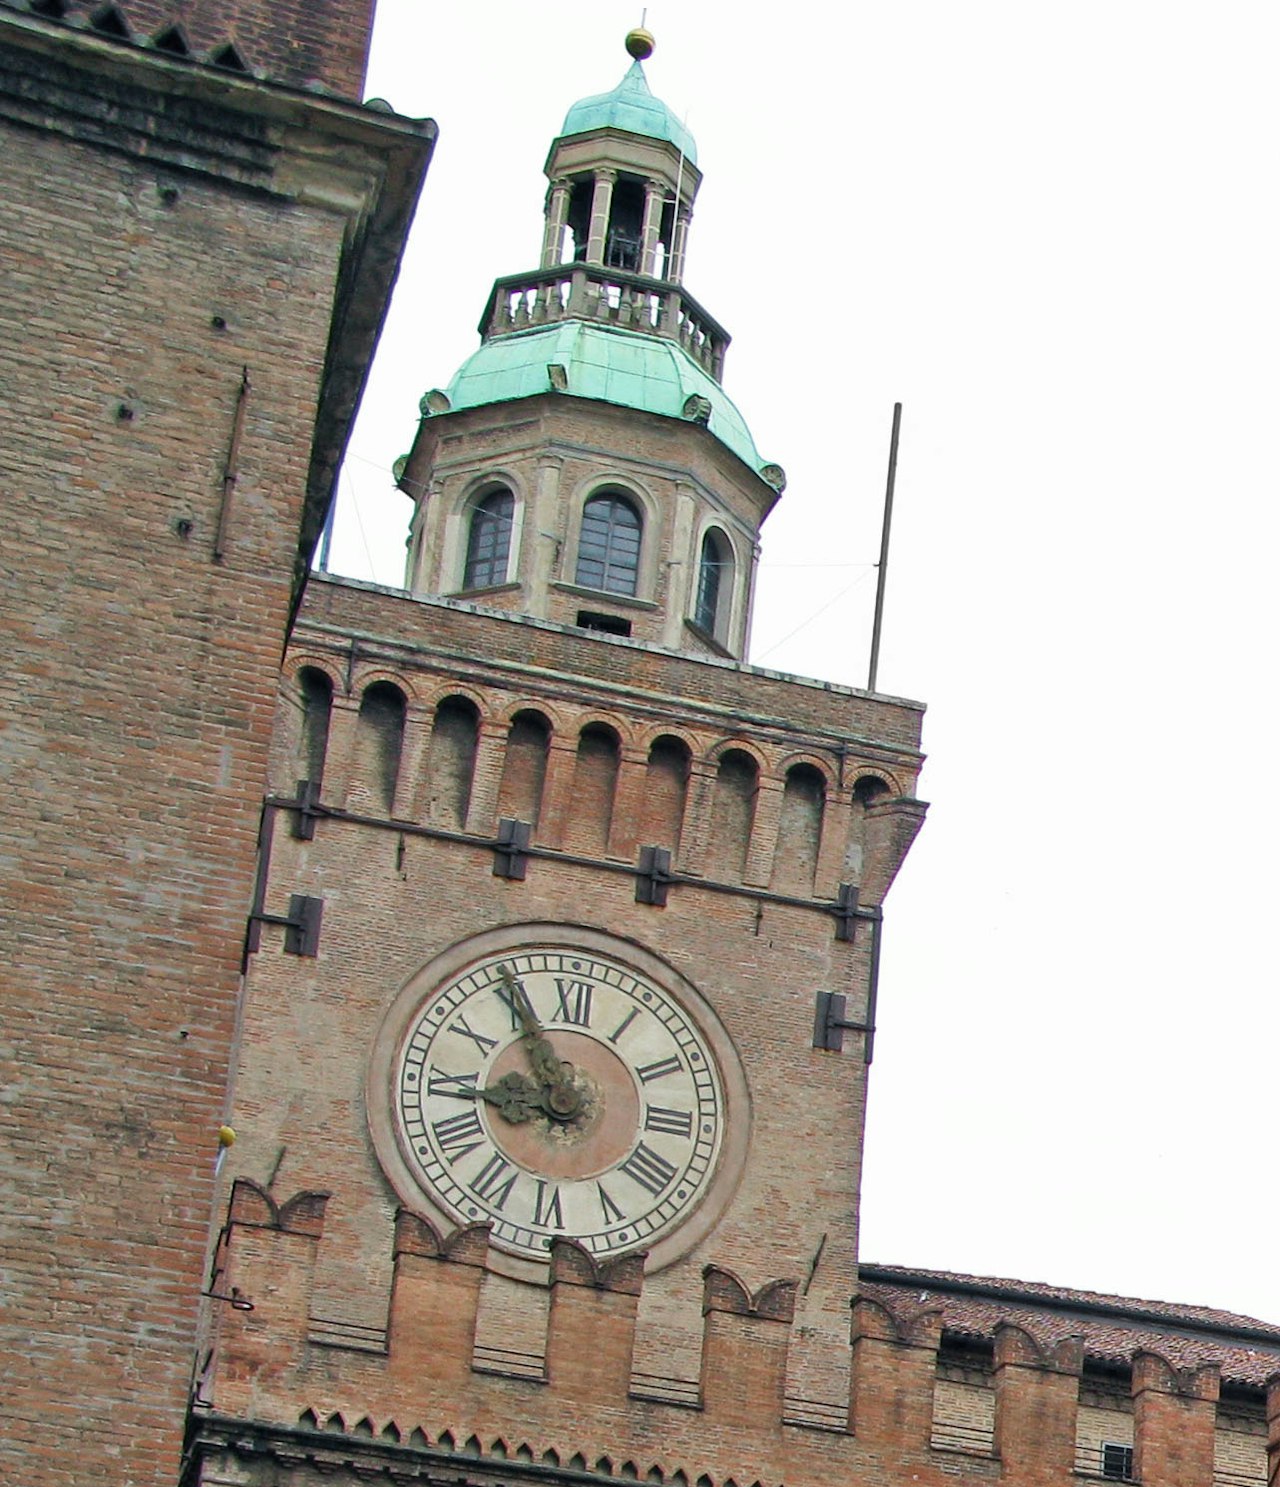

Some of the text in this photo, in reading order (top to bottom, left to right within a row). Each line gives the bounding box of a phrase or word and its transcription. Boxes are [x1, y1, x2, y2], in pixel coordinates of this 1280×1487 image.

[551, 979, 595, 1028] XII
[447, 1013, 499, 1058] X
[635, 1054, 684, 1085] II
[645, 1104, 693, 1140] III
[468, 1151, 520, 1212] VII
[618, 1140, 679, 1198] IIII
[531, 1179, 565, 1229] VI
[597, 1180, 626, 1225] V
